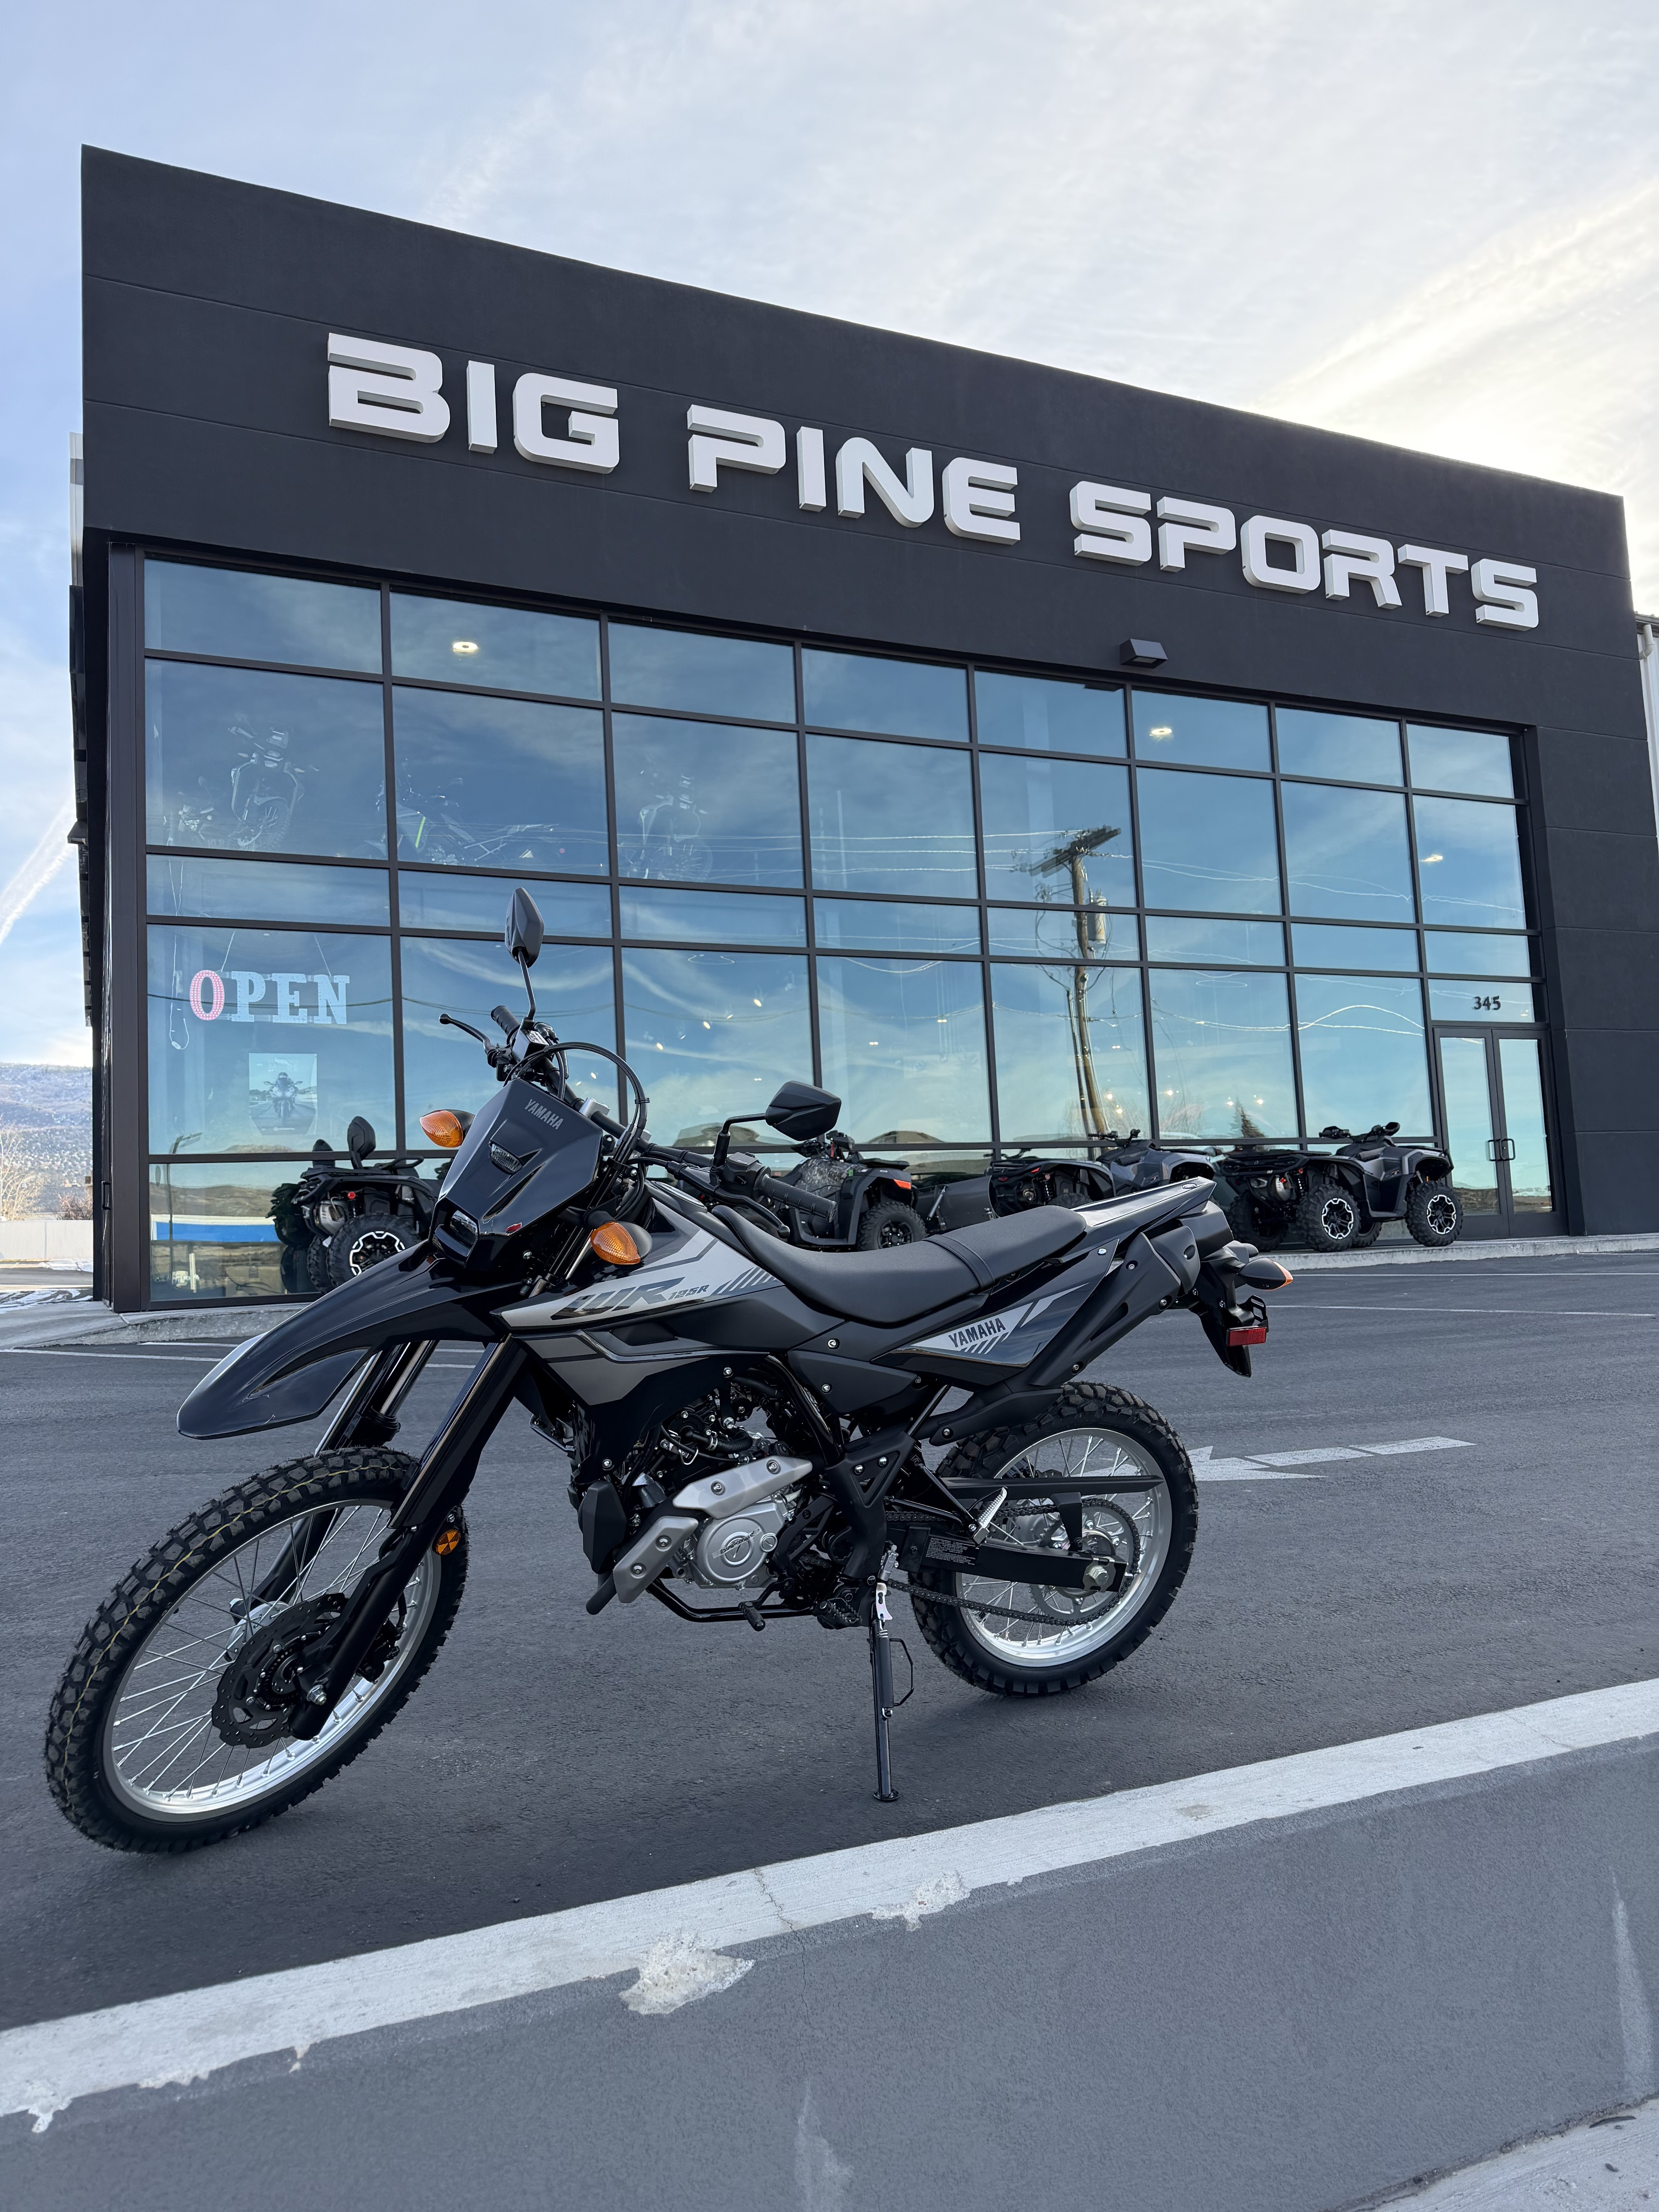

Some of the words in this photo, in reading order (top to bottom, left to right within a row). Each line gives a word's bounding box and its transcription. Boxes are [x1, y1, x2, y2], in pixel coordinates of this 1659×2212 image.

[328, 332, 620, 474] BIG
[687, 404, 1021, 545] PINE
[1069, 481, 1539, 631] SPORTS
[189, 969, 350, 1024] OPEN
[1472, 995, 1501, 1011] 345
[524, 1099, 564, 1130] YAMAHA
[668, 1284, 710, 1300] 125R
[948, 1317, 1006, 1348] YAMAHA
